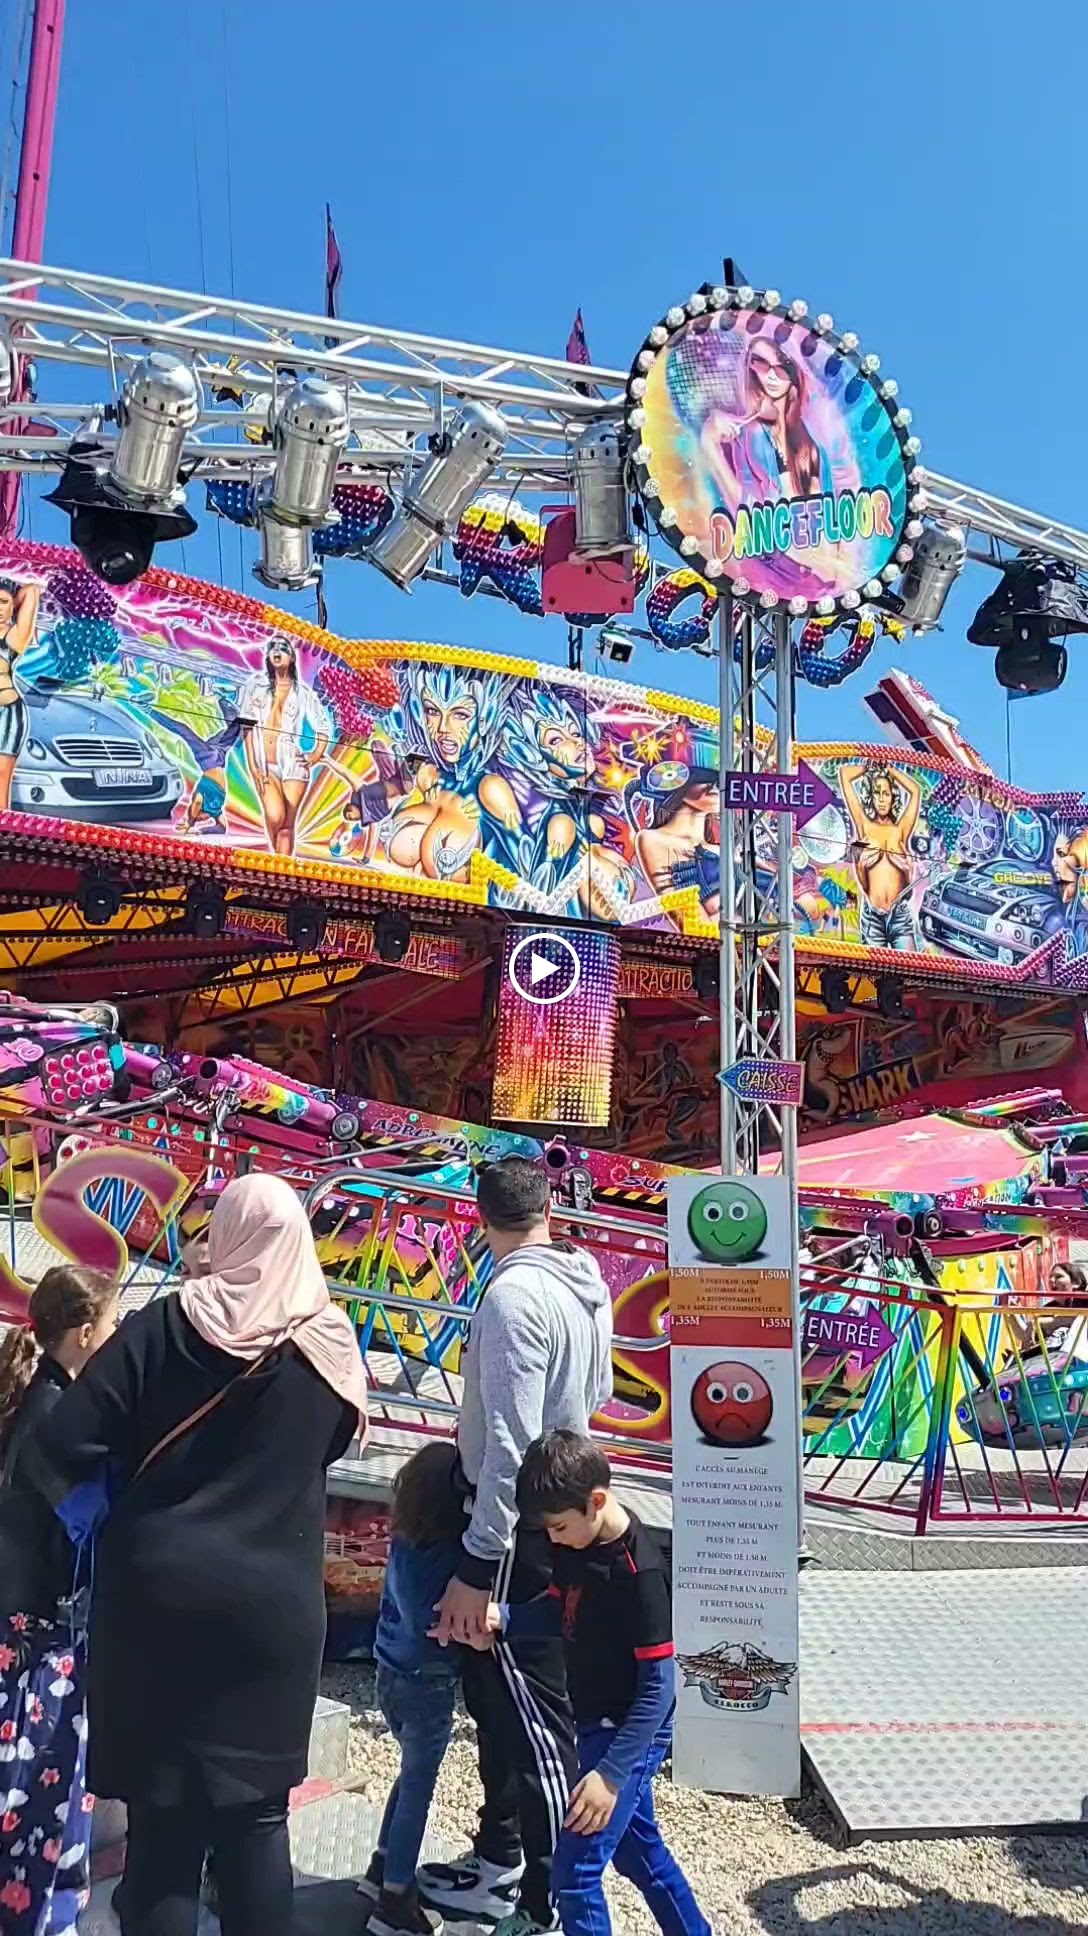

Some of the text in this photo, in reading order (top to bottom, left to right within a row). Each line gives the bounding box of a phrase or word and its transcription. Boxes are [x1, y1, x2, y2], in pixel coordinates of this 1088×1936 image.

[710, 488, 895, 562] DANCEFLOOR
[729, 779, 815, 806] ENTRÉE
[737, 1070, 799, 1094] CAISSE
[837, 1063, 912, 1116] SHARK
[373, 1118, 501, 1156] ADREALNE
[760, 1269, 791, 1280] 1,50M
[670, 1316, 791, 1328] 1,35M 1,35M
[807, 1316, 880, 1348] ENTRÉE
